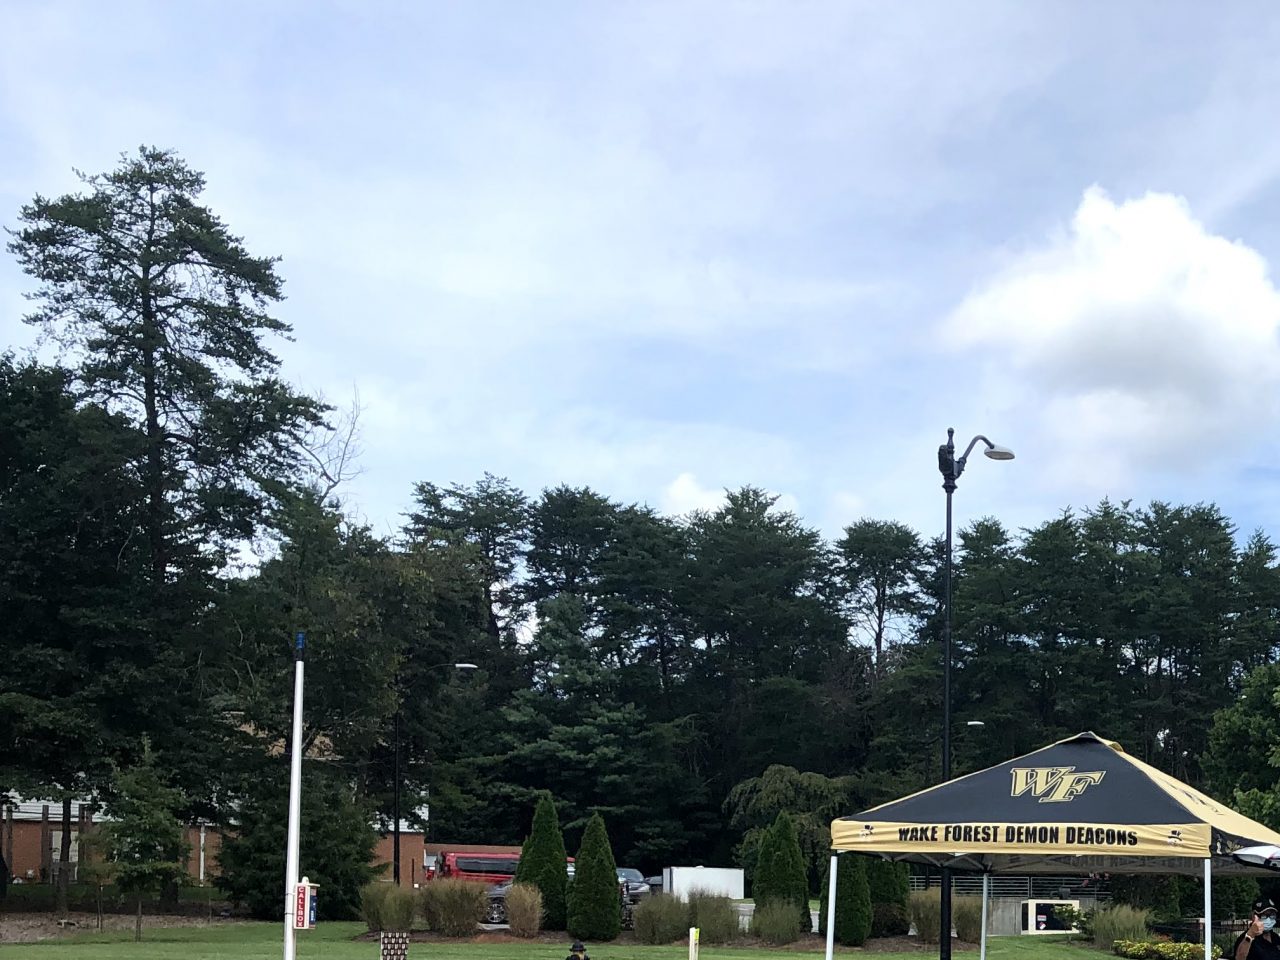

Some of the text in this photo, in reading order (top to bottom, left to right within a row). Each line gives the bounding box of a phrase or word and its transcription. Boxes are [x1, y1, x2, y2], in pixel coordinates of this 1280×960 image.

[1010, 766, 1106, 802] WF
[899, 825, 1138, 846] WAKE FOREST DEMON DEACONS
